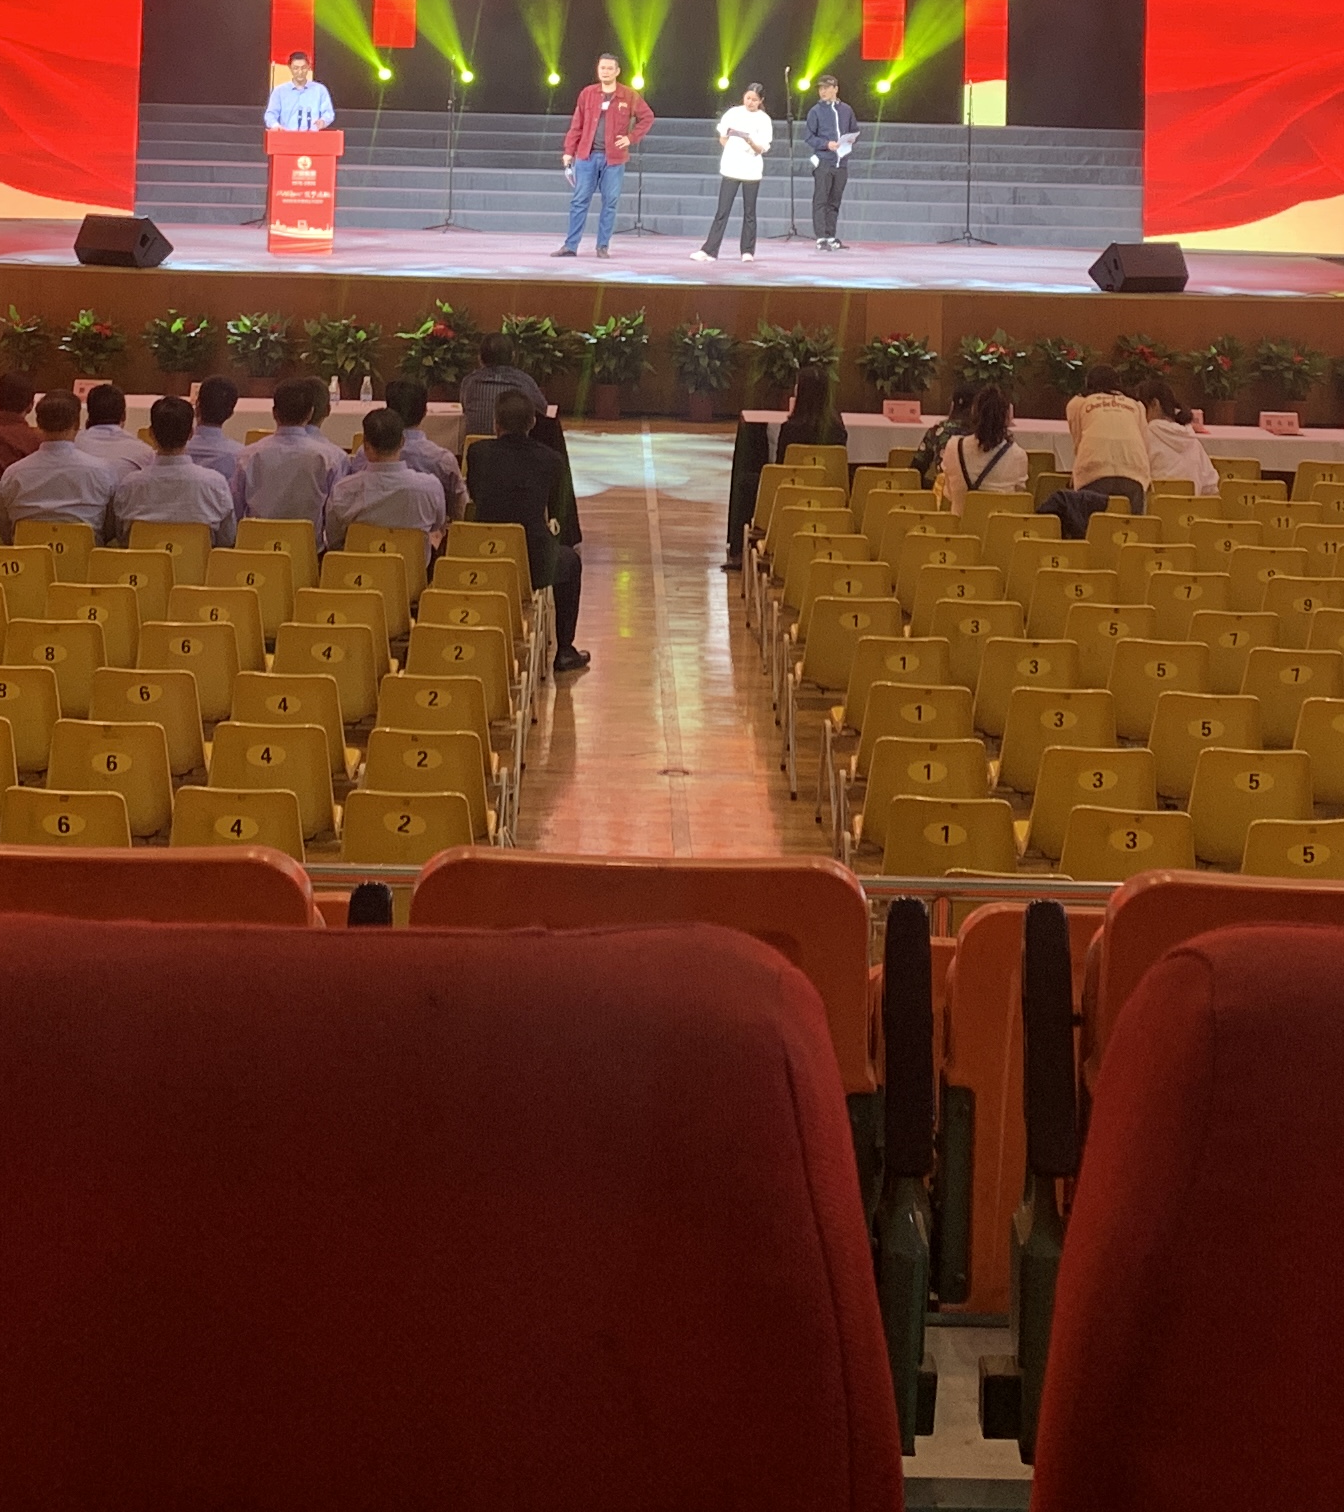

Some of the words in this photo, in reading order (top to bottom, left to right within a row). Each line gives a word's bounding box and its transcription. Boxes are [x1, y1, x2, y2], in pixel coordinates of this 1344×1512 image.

[1244, 495, 1255, 505] 11
[1277, 518, 1289, 528] 11
[488, 542, 497, 554] 2
[1324, 542, 1337, 553] 11
[2, 561, 19, 575] 10
[1075, 585, 1083, 597] 5
[87, 608, 97, 621] 8
[327, 613, 335, 625] 4
[460, 610, 469, 624] 2
[1109, 623, 1118, 636] 5
[45, 646, 55, 661] 8
[181, 639, 191, 654] 6
[322, 646, 332, 660] 4
[1157, 663, 1166, 677] 5
[1291, 668, 1300, 682] 7
[140, 686, 150, 701] 6
[428, 691, 438, 706] 2
[278, 697, 288, 712] 4
[1054, 712, 1064, 727] 3
[1202, 721, 1211, 737] 5
[106, 755, 117, 771] 6
[261, 747, 272, 764] 4
[417, 751, 427, 767] 2
[1093, 772, 1103, 788] 3
[1249, 774, 1260, 790] 5
[58, 816, 70, 833] 6
[230, 819, 242, 838] 4
[397, 815, 411, 833] 2
[941, 825, 949, 844] 1
[1125, 831, 1137, 849] 3
[1303, 846, 1315, 863] 5
